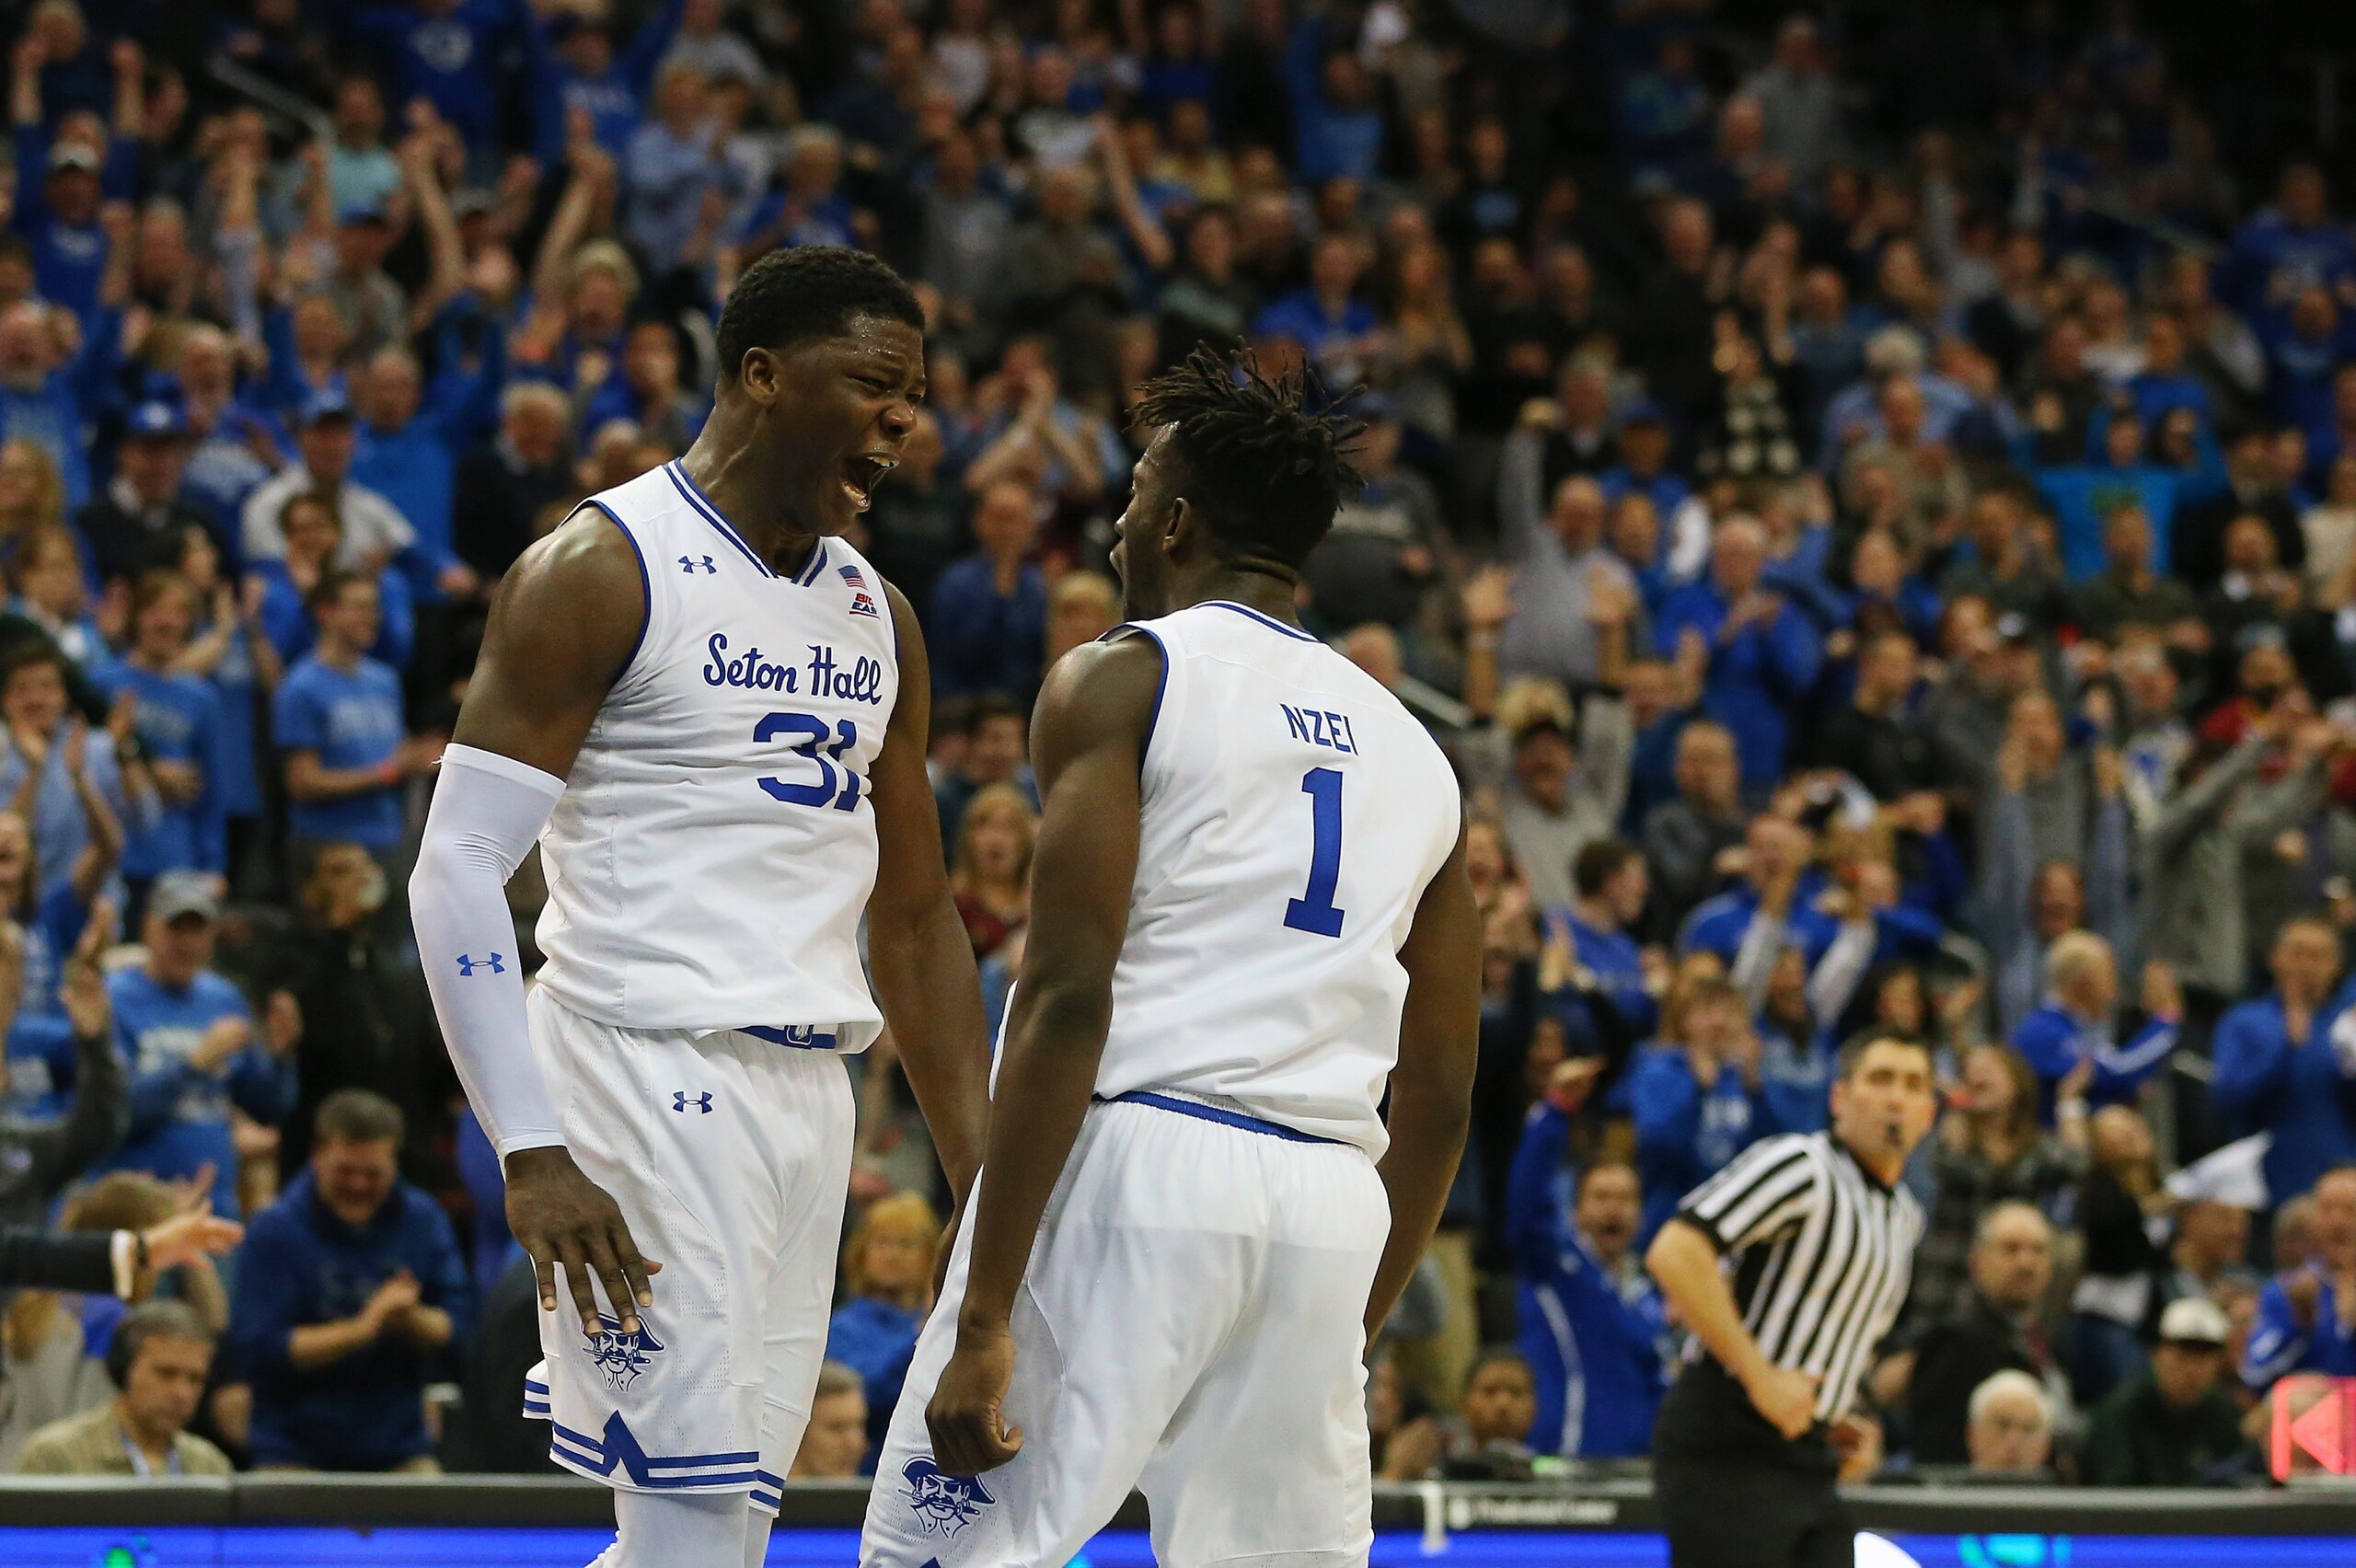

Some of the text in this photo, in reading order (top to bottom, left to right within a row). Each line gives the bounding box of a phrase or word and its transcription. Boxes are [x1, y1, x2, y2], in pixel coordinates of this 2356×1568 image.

[703, 632, 883, 705] Seton Hall
[752, 711, 861, 813] 31
[1279, 703, 1359, 756] NZEI
[1283, 767, 1345, 939] 1
